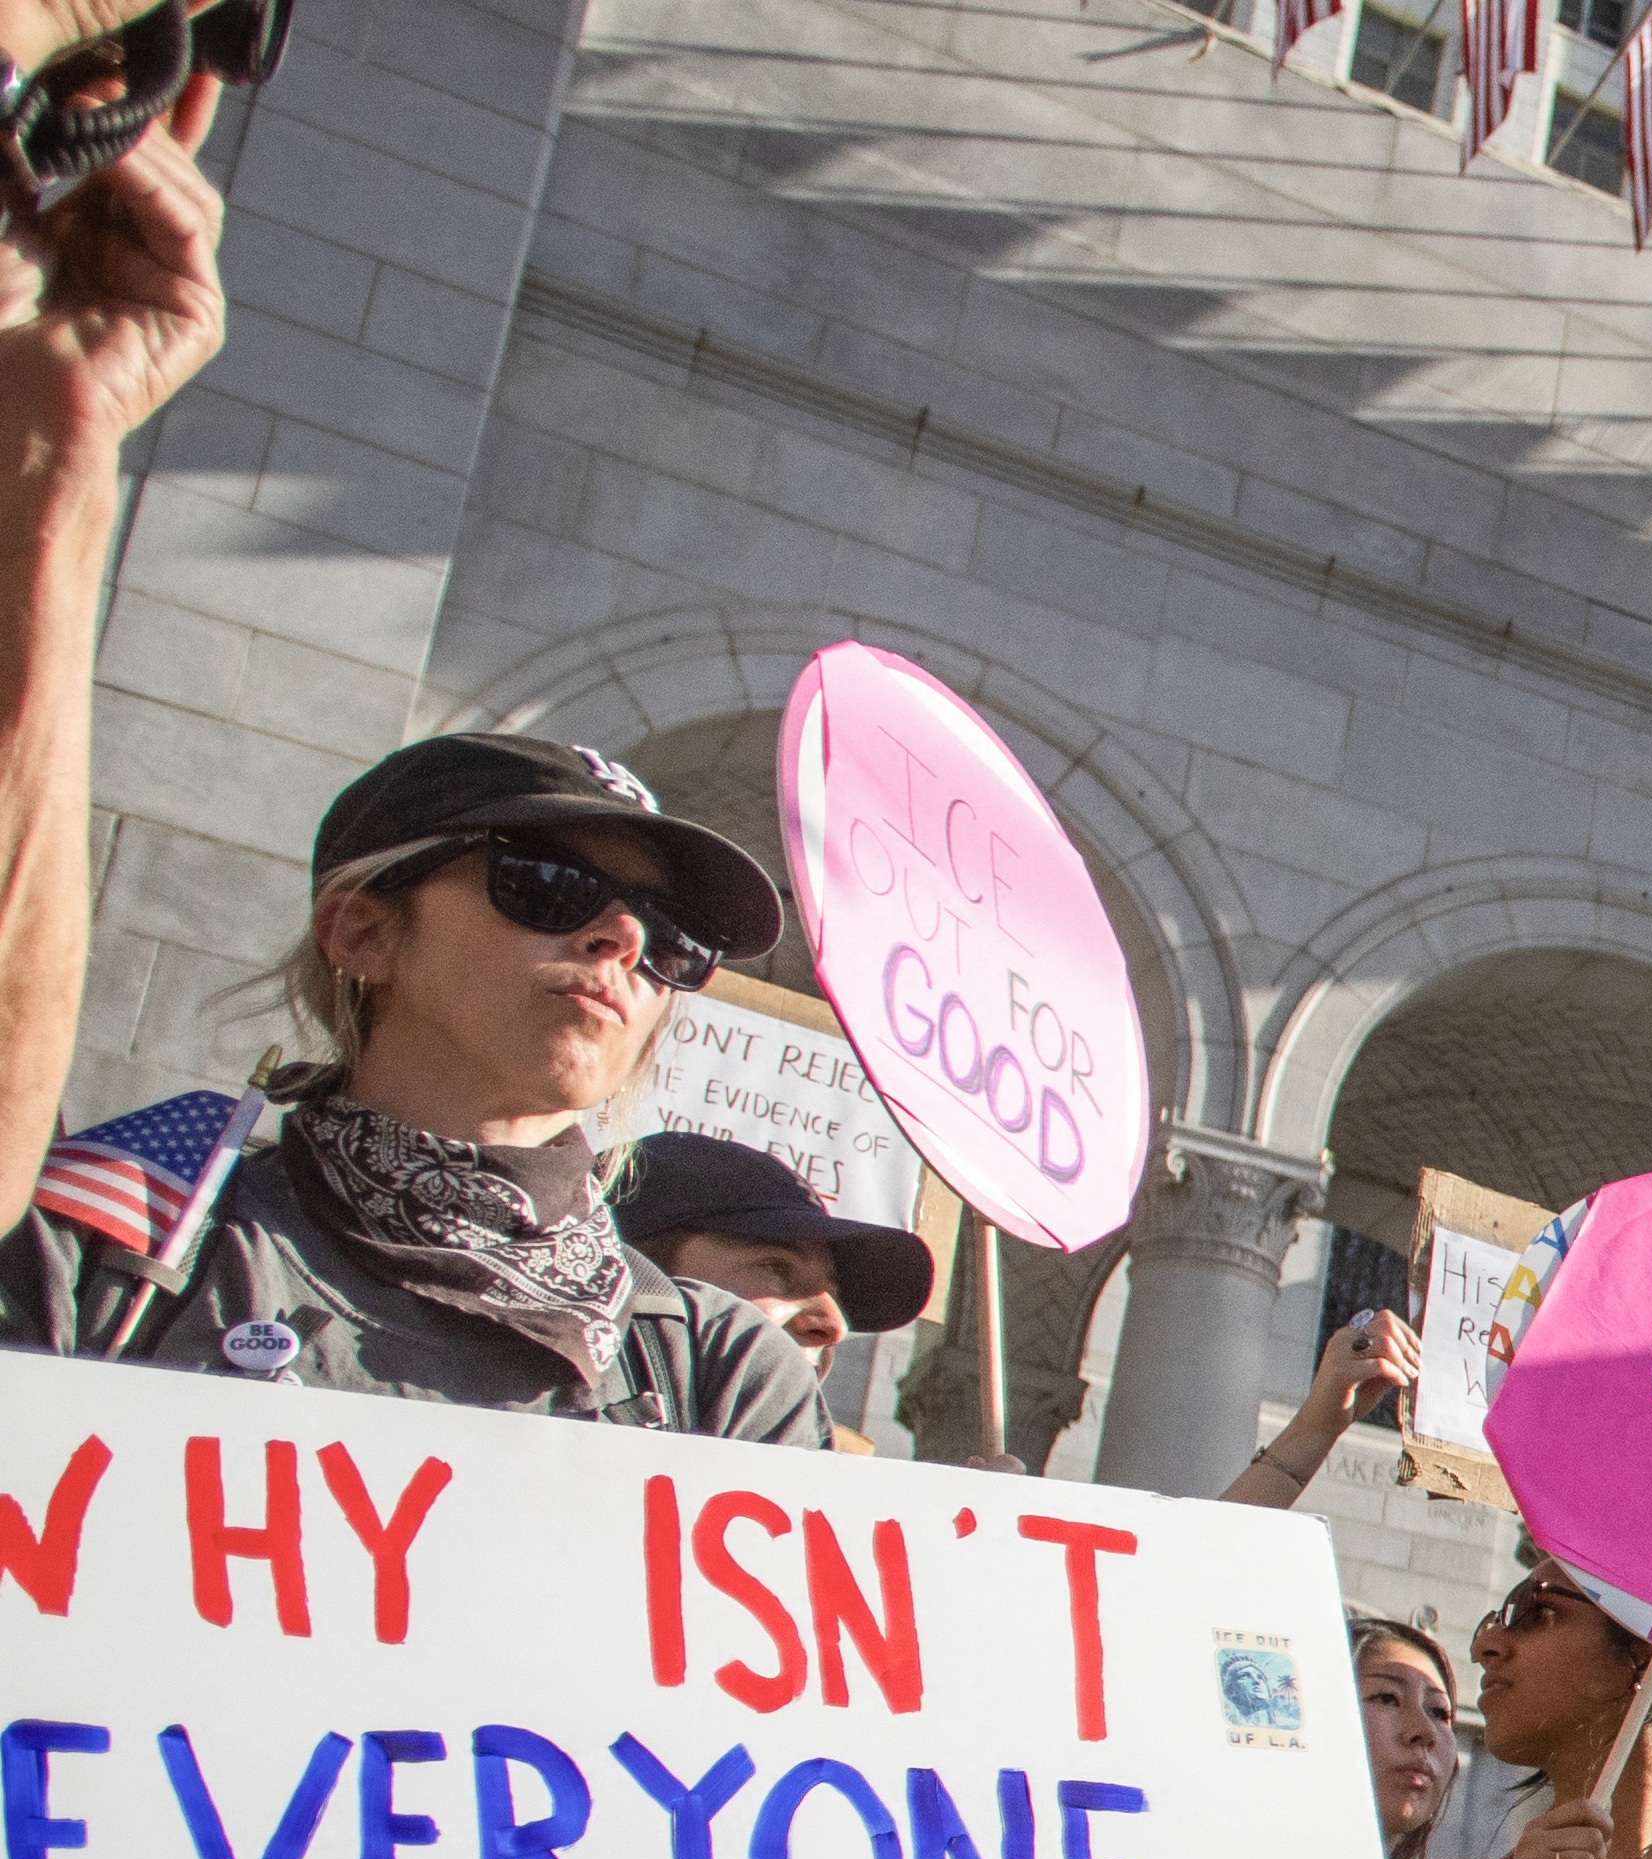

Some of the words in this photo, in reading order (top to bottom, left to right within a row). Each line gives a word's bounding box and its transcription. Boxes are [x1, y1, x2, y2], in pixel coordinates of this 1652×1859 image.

[877, 724, 1036, 958] ICE
[849, 817, 972, 977] OUT
[1007, 968, 1103, 1119] FOR
[673, 1016, 764, 1062] ON'T
[777, 1043, 875, 1104] REJEC
[881, 941, 1086, 1185] GOOD
[703, 1078, 843, 1141] EVIDENCE
[852, 1130, 890, 1159] OF
[229, 1337, 293, 1352] GOOD
[249, 1324, 276, 1337] BE
[644, 1474, 1139, 1742] ISN'T
[1255, 1634, 1291, 1649] OUT
